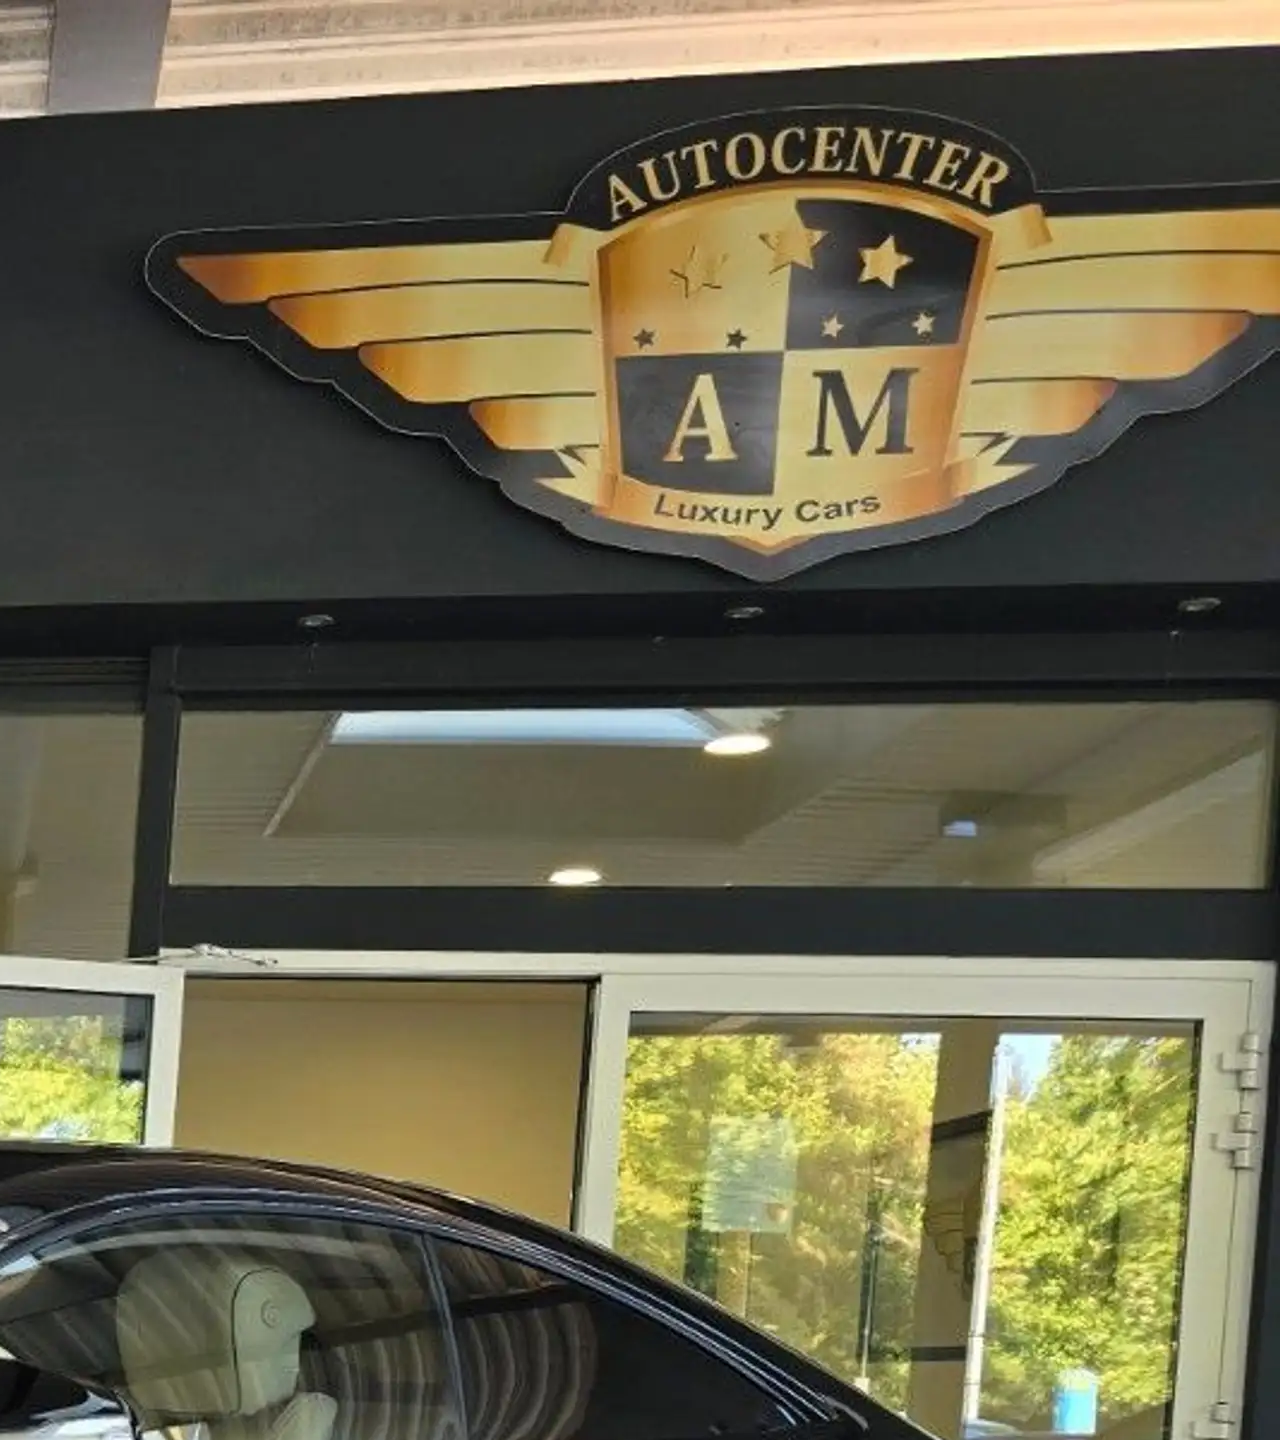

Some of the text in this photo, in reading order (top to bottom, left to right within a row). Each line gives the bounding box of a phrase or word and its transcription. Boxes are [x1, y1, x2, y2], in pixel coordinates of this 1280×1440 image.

[607, 126, 1010, 222] AUTOCENTER
[662, 367, 919, 462] A M
[653, 493, 881, 531] Luxury Cars
